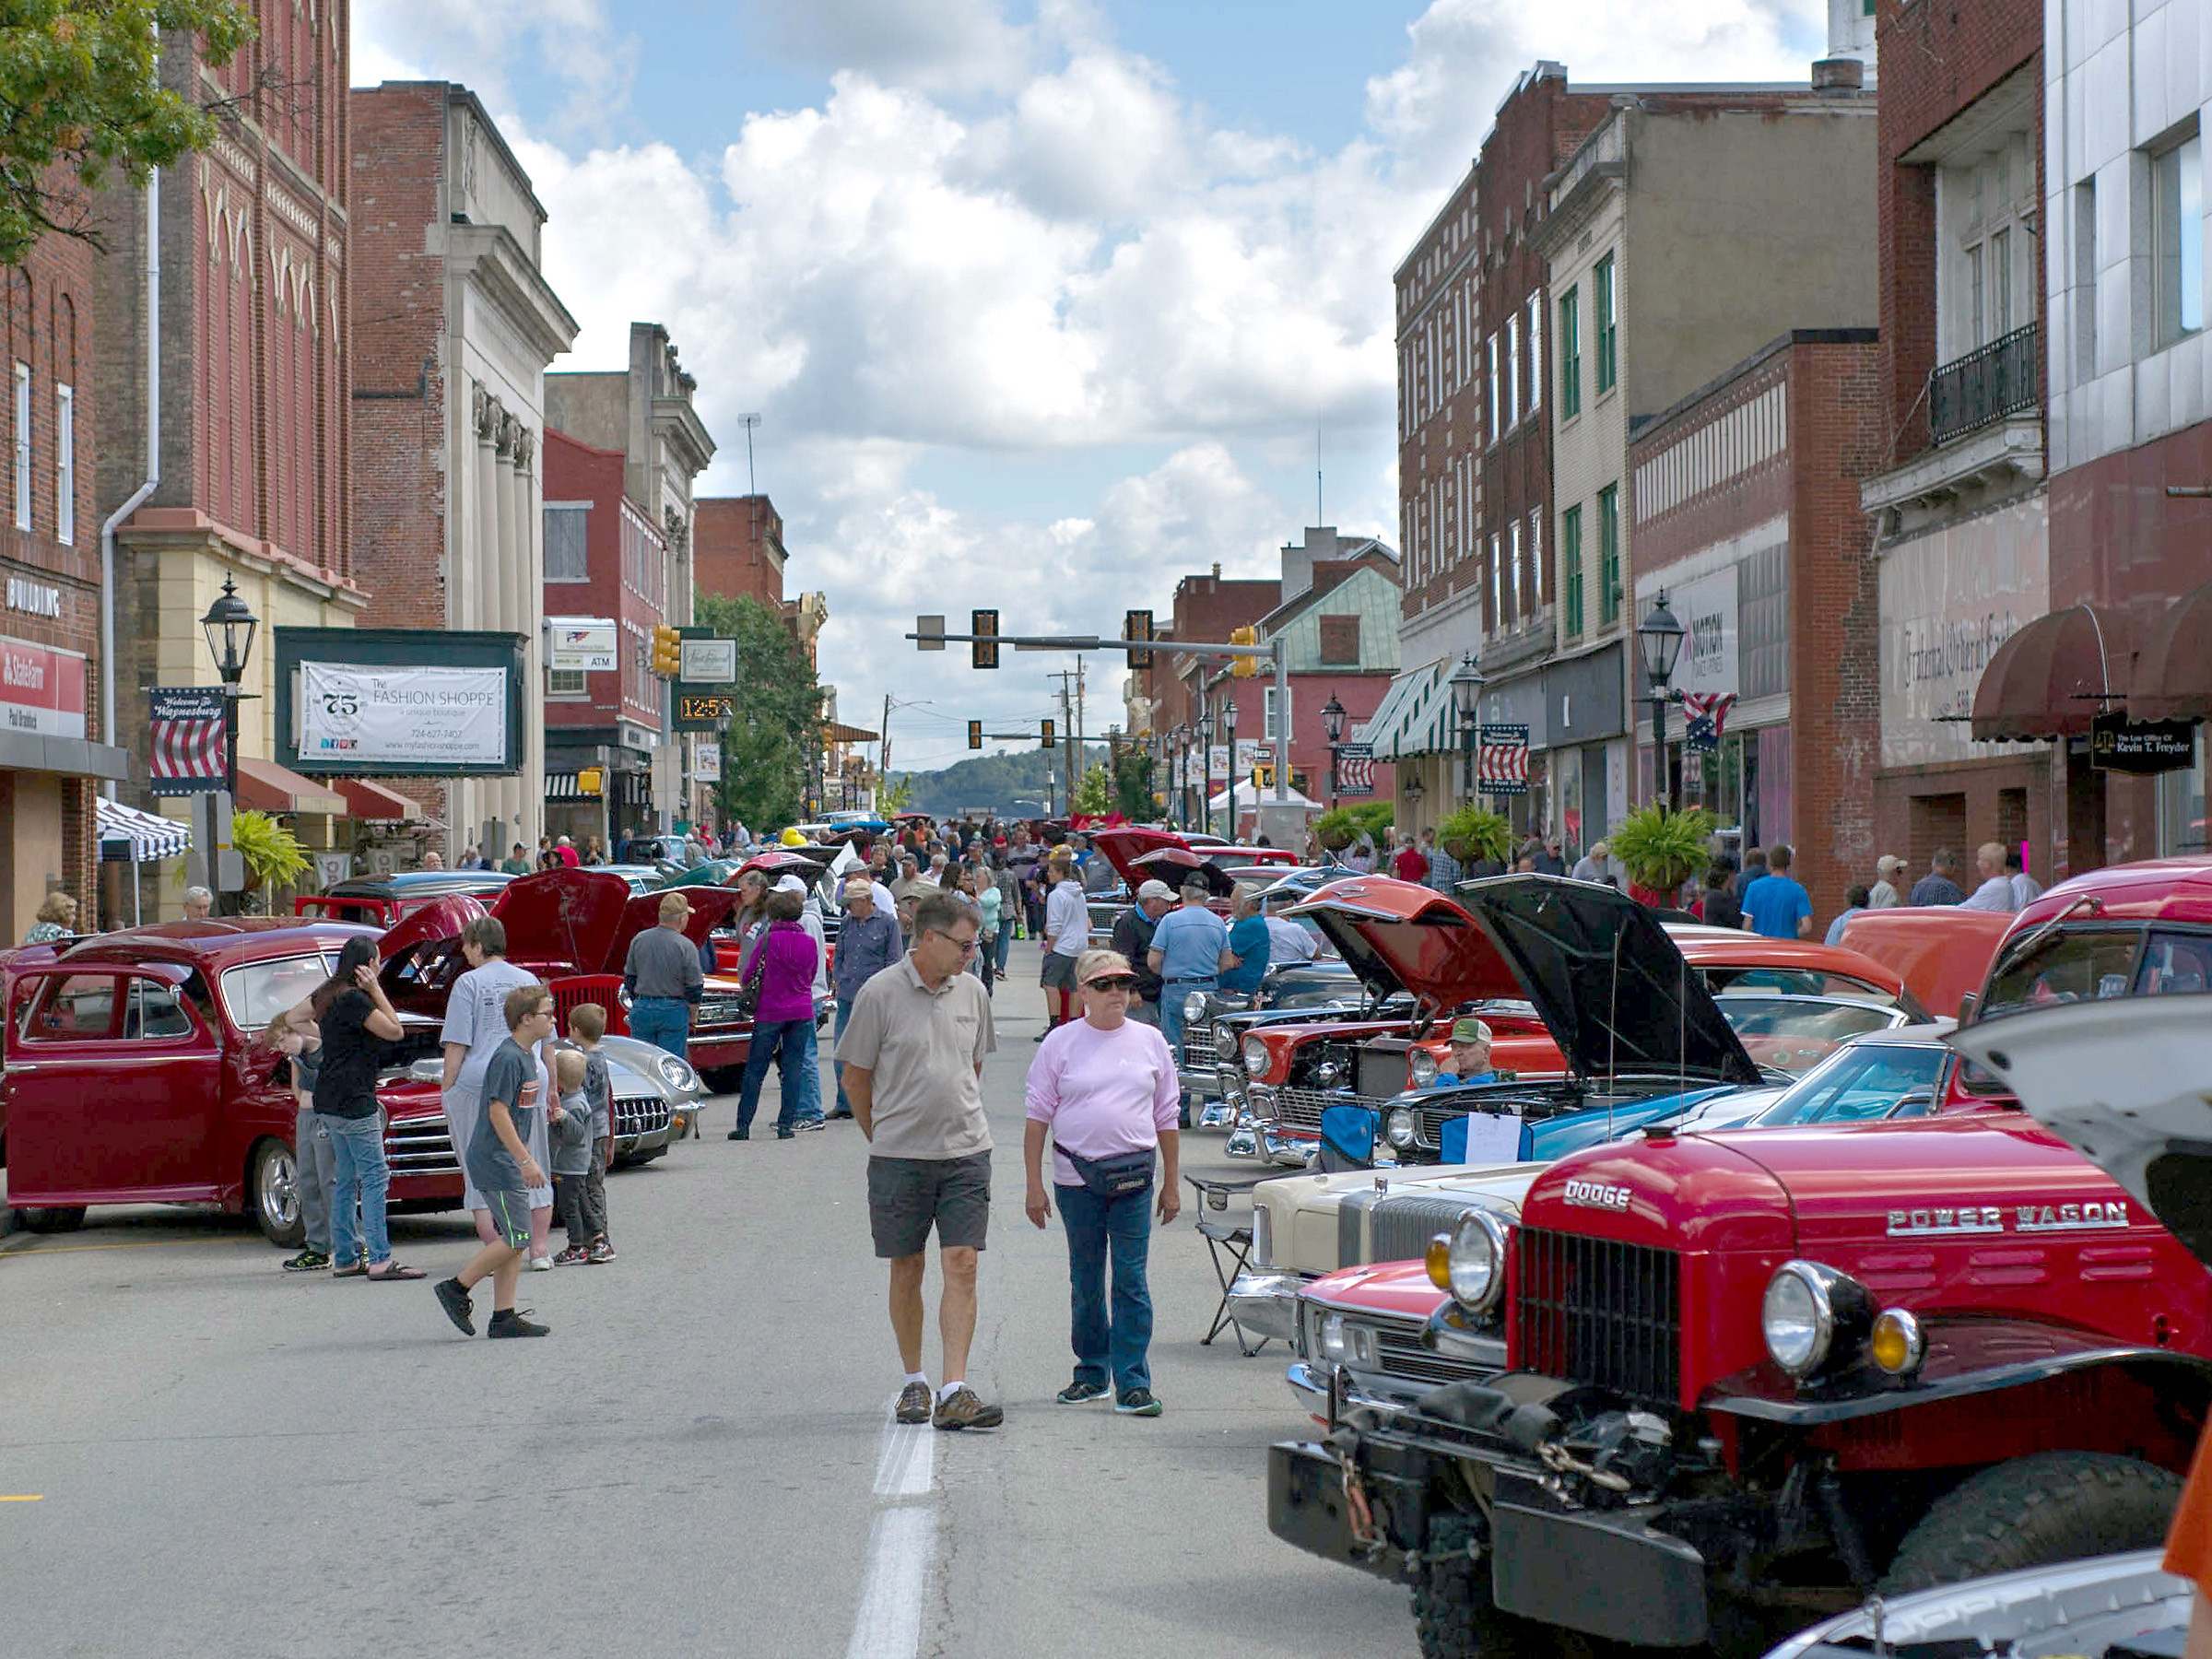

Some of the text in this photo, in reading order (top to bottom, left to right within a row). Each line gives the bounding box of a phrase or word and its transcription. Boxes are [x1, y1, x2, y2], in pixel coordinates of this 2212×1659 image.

[6, 578, 60, 618] BUILDING
[1692, 612, 1723, 657] MOTION
[591, 657, 610, 666] ATM
[371, 678, 386, 688] The
[164, 696, 212, 707] Welcome To
[323, 693, 359, 715] 75
[373, 689, 434, 704] FASHION
[439, 691, 495, 706] SHOPPE
[154, 705, 222, 719] Waynesburg
[432, 708, 466, 717] boutique
[2117, 743, 2143, 752] Kevin
[1564, 1180, 1631, 1209] DODGE
[1888, 1201, 2128, 1230] POWER WAGON
